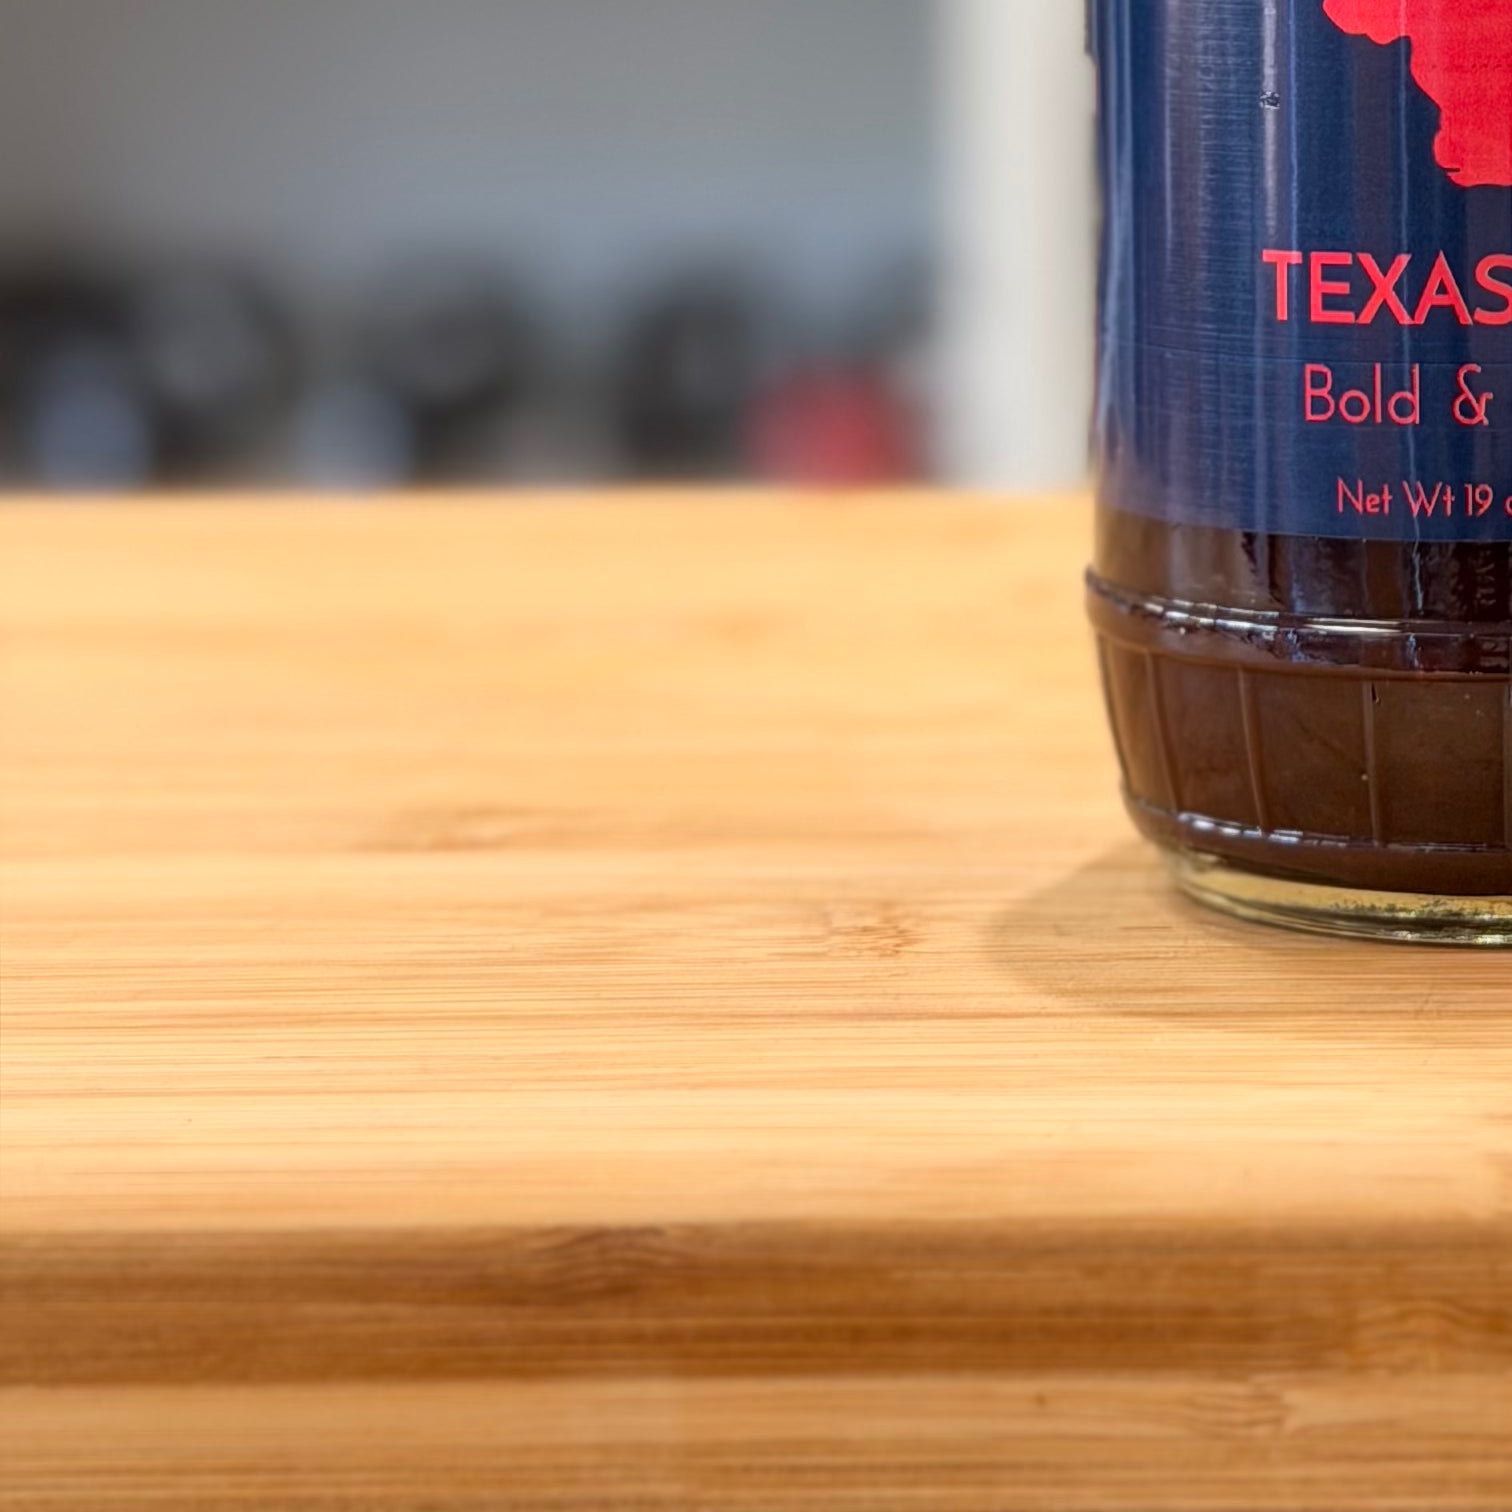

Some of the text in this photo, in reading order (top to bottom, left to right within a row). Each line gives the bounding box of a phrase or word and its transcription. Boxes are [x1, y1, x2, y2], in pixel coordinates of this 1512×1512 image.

[1303, 364, 1420, 425] Bold
[1451, 365, 1493, 426] &
[1336, 476, 1393, 516] Net
[1402, 479, 1455, 517] Wt
[1464, 483, 1493, 517] 19
